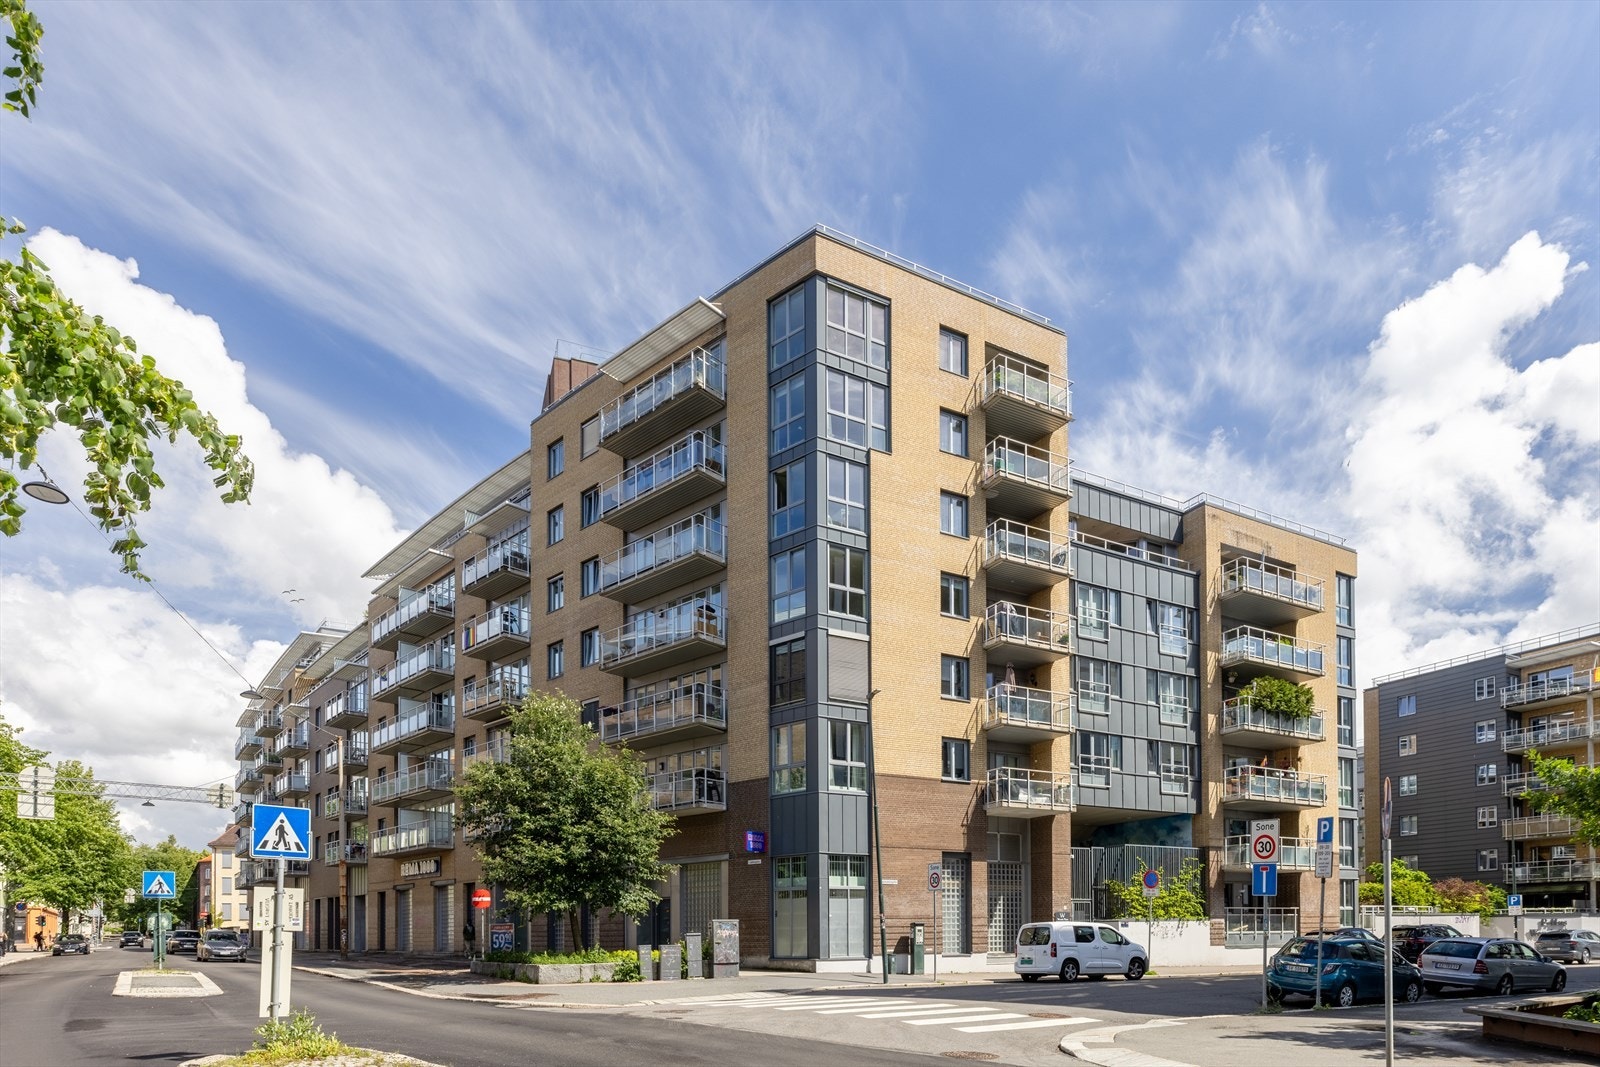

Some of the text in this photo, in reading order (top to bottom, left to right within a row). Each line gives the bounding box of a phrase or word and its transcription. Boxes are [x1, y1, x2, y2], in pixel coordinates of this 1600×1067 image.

[1255, 823, 1275, 831] Sone
[1320, 820, 1330, 840] P
[1258, 841, 1272, 853] 30
[1510, 896, 1518, 905] P
[492, 934, 505, 949] 59
